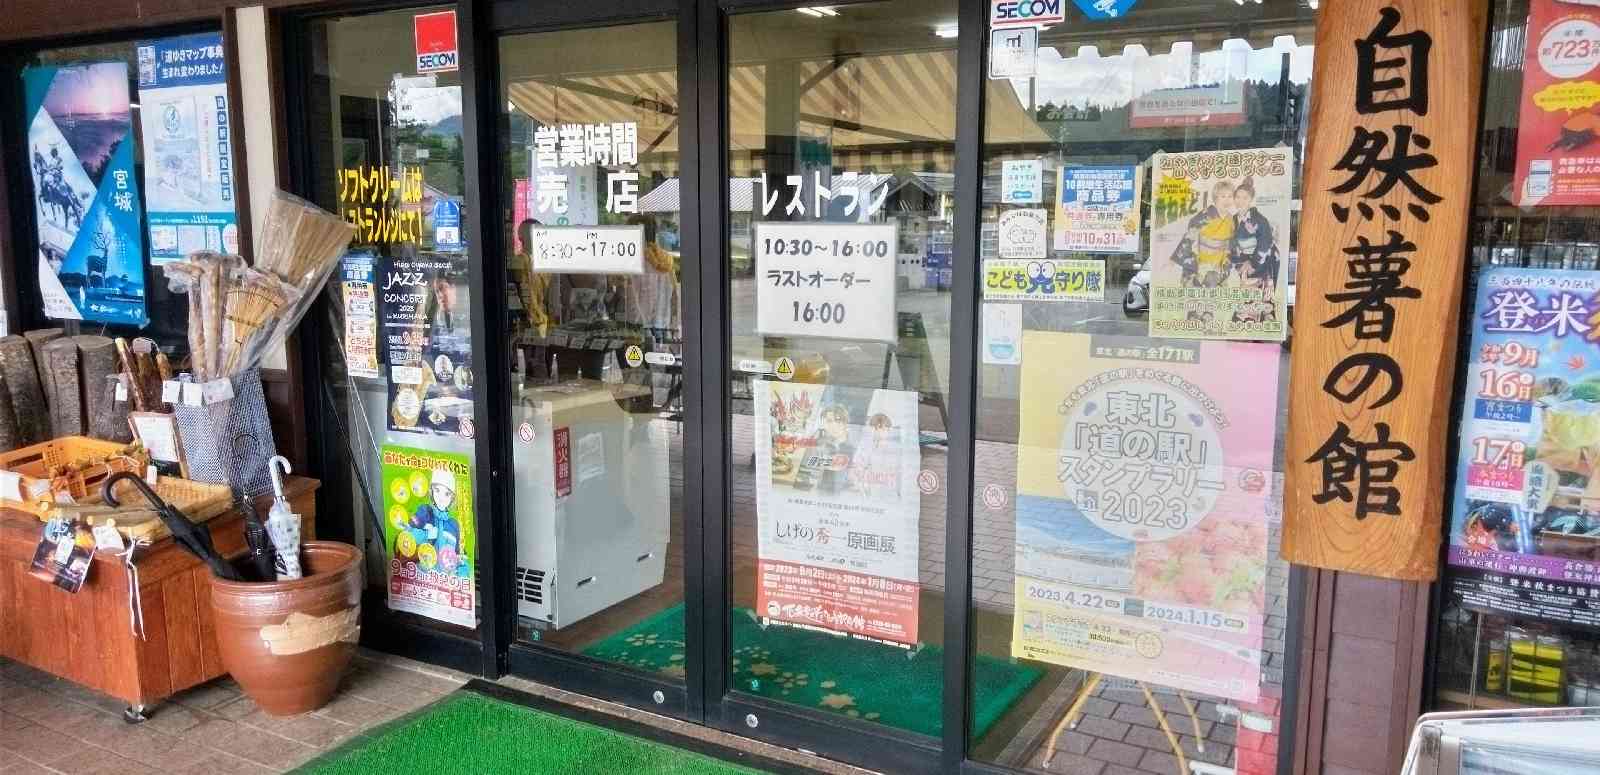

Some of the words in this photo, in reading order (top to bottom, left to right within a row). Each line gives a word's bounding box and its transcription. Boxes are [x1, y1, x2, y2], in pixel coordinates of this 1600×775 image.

[997, 0, 1060, 18] SECOM
[419, 53, 456, 69] SECOM
[534, 121, 639, 168] 営業時間
[112, 169, 133, 212] 宮城
[337, 165, 423, 204] ソフトクリームは
[761, 170, 889, 218] レストラン
[764, 238, 889, 258] 10:30～16:00
[1304, 6, 1445, 521] 自然薯の館
[383, 271, 428, 290] JAZZ
[384, 293, 428, 305] CONCERT
[767, 270, 871, 289] ラストオーダー
[792, 301, 846, 325] 16:00
[1481, 290, 1593, 338] 登米
[1104, 390, 1177, 429] 東北
[556, 431, 569, 479] 消火器
[1073, 421, 1209, 468] 「道の駅」
[1057, 455, 1226, 498] スタンプラリー
[1102, 489, 1188, 530] 2023
[776, 520, 897, 555] しげの秀一原画展
[1029, 586, 1104, 609] 2023.4.22
[1146, 606, 1223, 628] 2024.1.15
